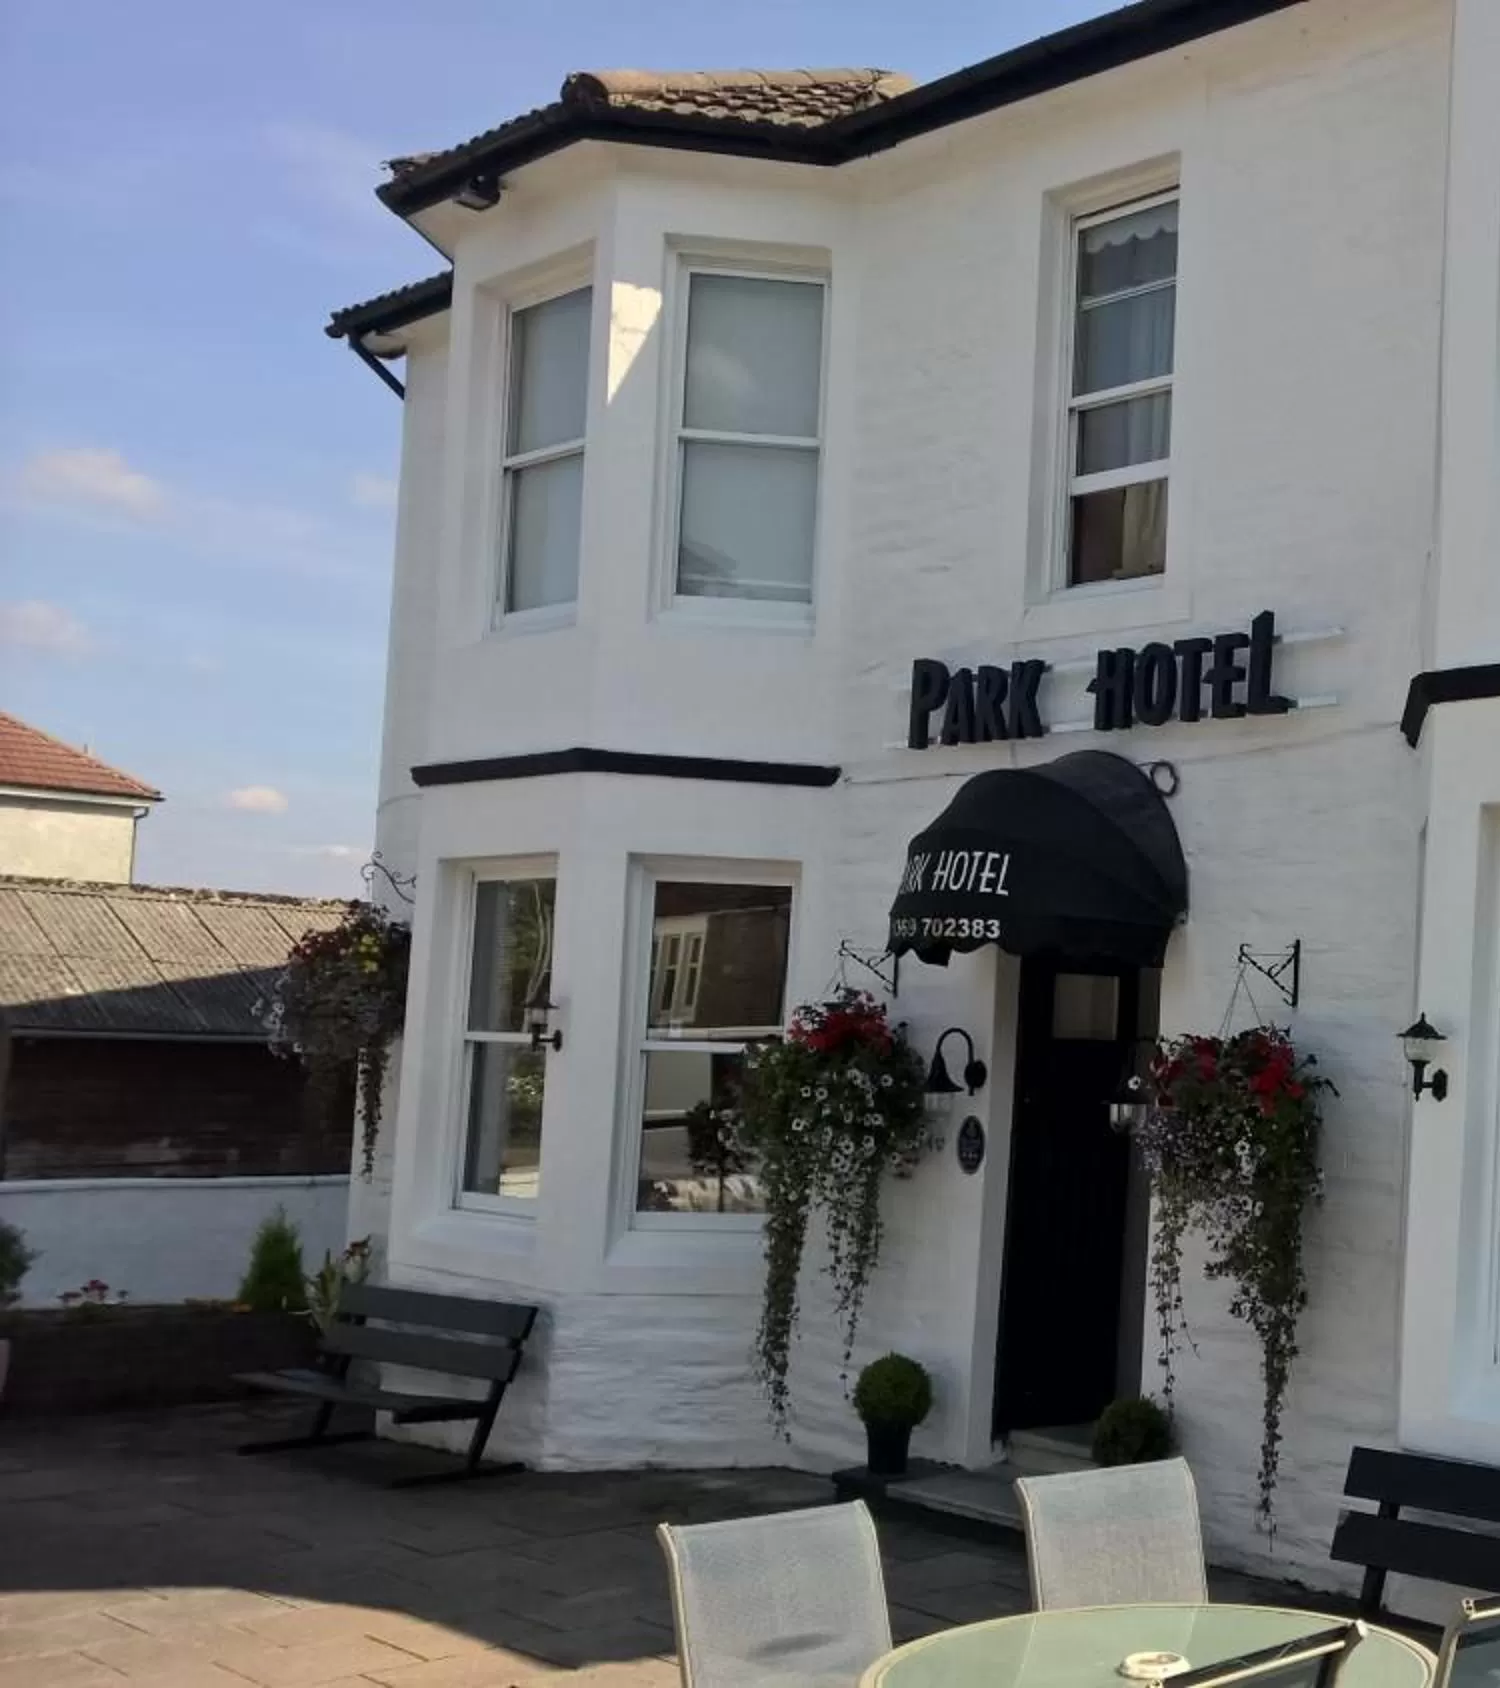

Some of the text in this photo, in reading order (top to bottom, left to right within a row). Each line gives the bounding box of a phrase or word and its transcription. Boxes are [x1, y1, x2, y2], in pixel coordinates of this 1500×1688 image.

[908, 610, 1297, 749] PARK HOTEL
[931, 849, 1010, 897] HOTEL
[921, 917, 1001, 940] 702383
